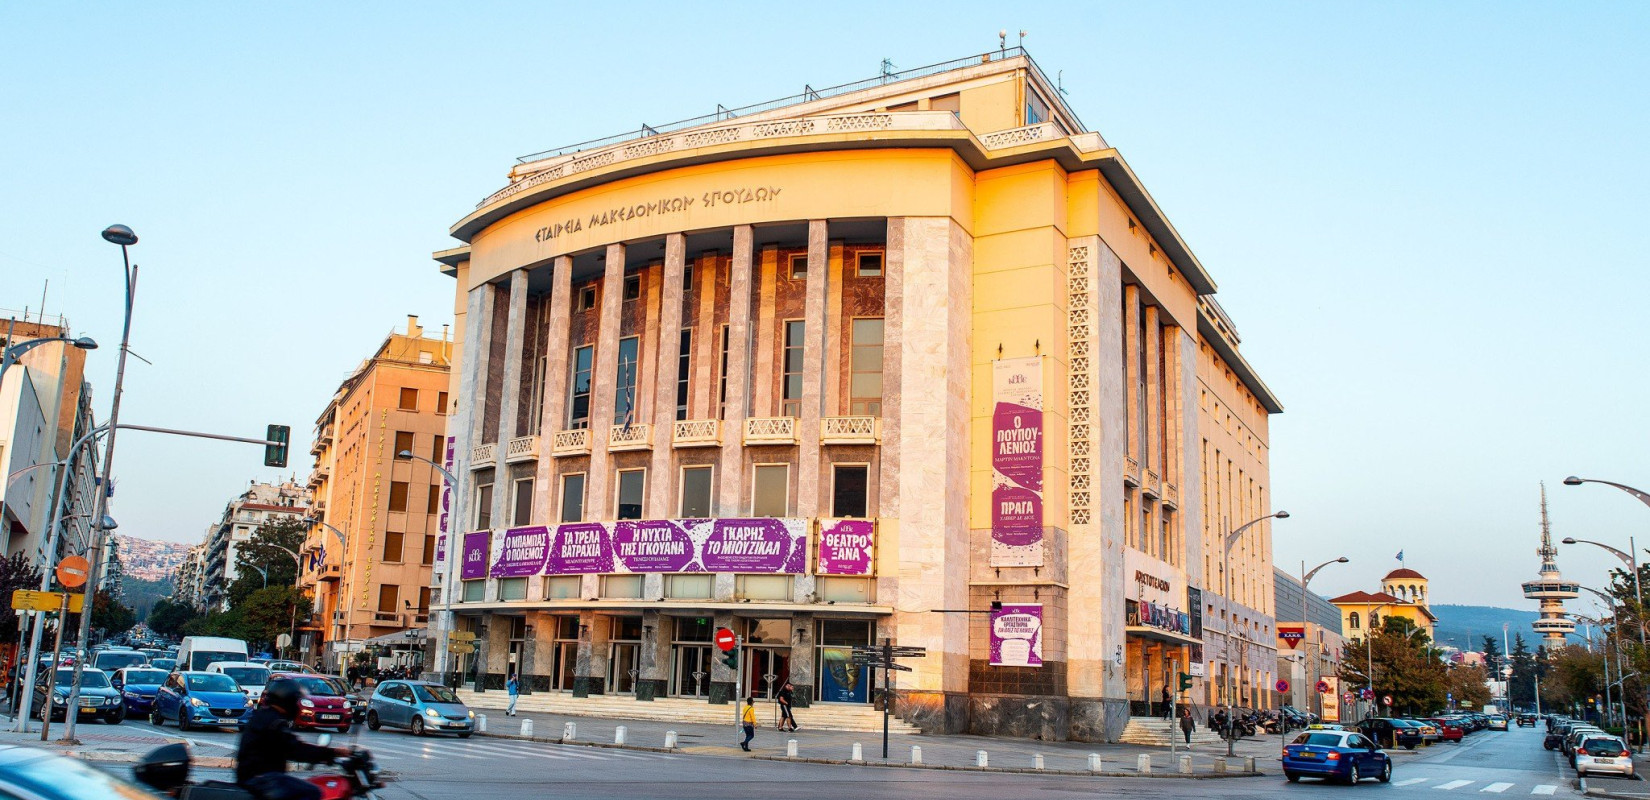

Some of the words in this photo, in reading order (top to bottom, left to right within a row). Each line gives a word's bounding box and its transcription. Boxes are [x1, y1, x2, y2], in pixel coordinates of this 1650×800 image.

[535, 218, 582, 243] ΕΤΑΙΡΕΙΑ
[588, 196, 695, 229] ΜΑΚΕΔΟΝΙΚΩΝ
[1013, 416, 1022, 429] Ο
[997, 427, 1042, 442] ΠΟΥΠΟΥ-
[999, 440, 1036, 455] ΛΕΝΙΟΣ
[1001, 501, 1034, 515] ΠΡΑΓΑ
[506, 537, 511, 549] Ο
[512, 533, 547, 548] ΜΠΑΜΠΑΣ
[564, 531, 573, 545] ΤΑ
[574, 530, 600, 545] ΤΡΕΛΑ
[633, 529, 640, 542] Η
[641, 528, 672, 542] ΝΥΧΤΑ
[723, 526, 765, 541] ΓΚΑΡΗΣ
[826, 533, 867, 548] ΘΕΑΤΡΟ
[506, 549, 511, 561] Ο
[512, 547, 544, 561] ΠΟΛΕΜΟΣ
[561, 543, 601, 558] ΒΑΤΡΑΧΙΑ
[620, 542, 637, 556] ΤΗΣ
[638, 541, 685, 556] ΙΓΚΟΥΑΝΑ
[707, 541, 720, 555] ΤΟ
[721, 540, 781, 555] ΜΙΟΥΖΙΚΑΛ
[831, 547, 860, 561] ΞΑΝΑ
